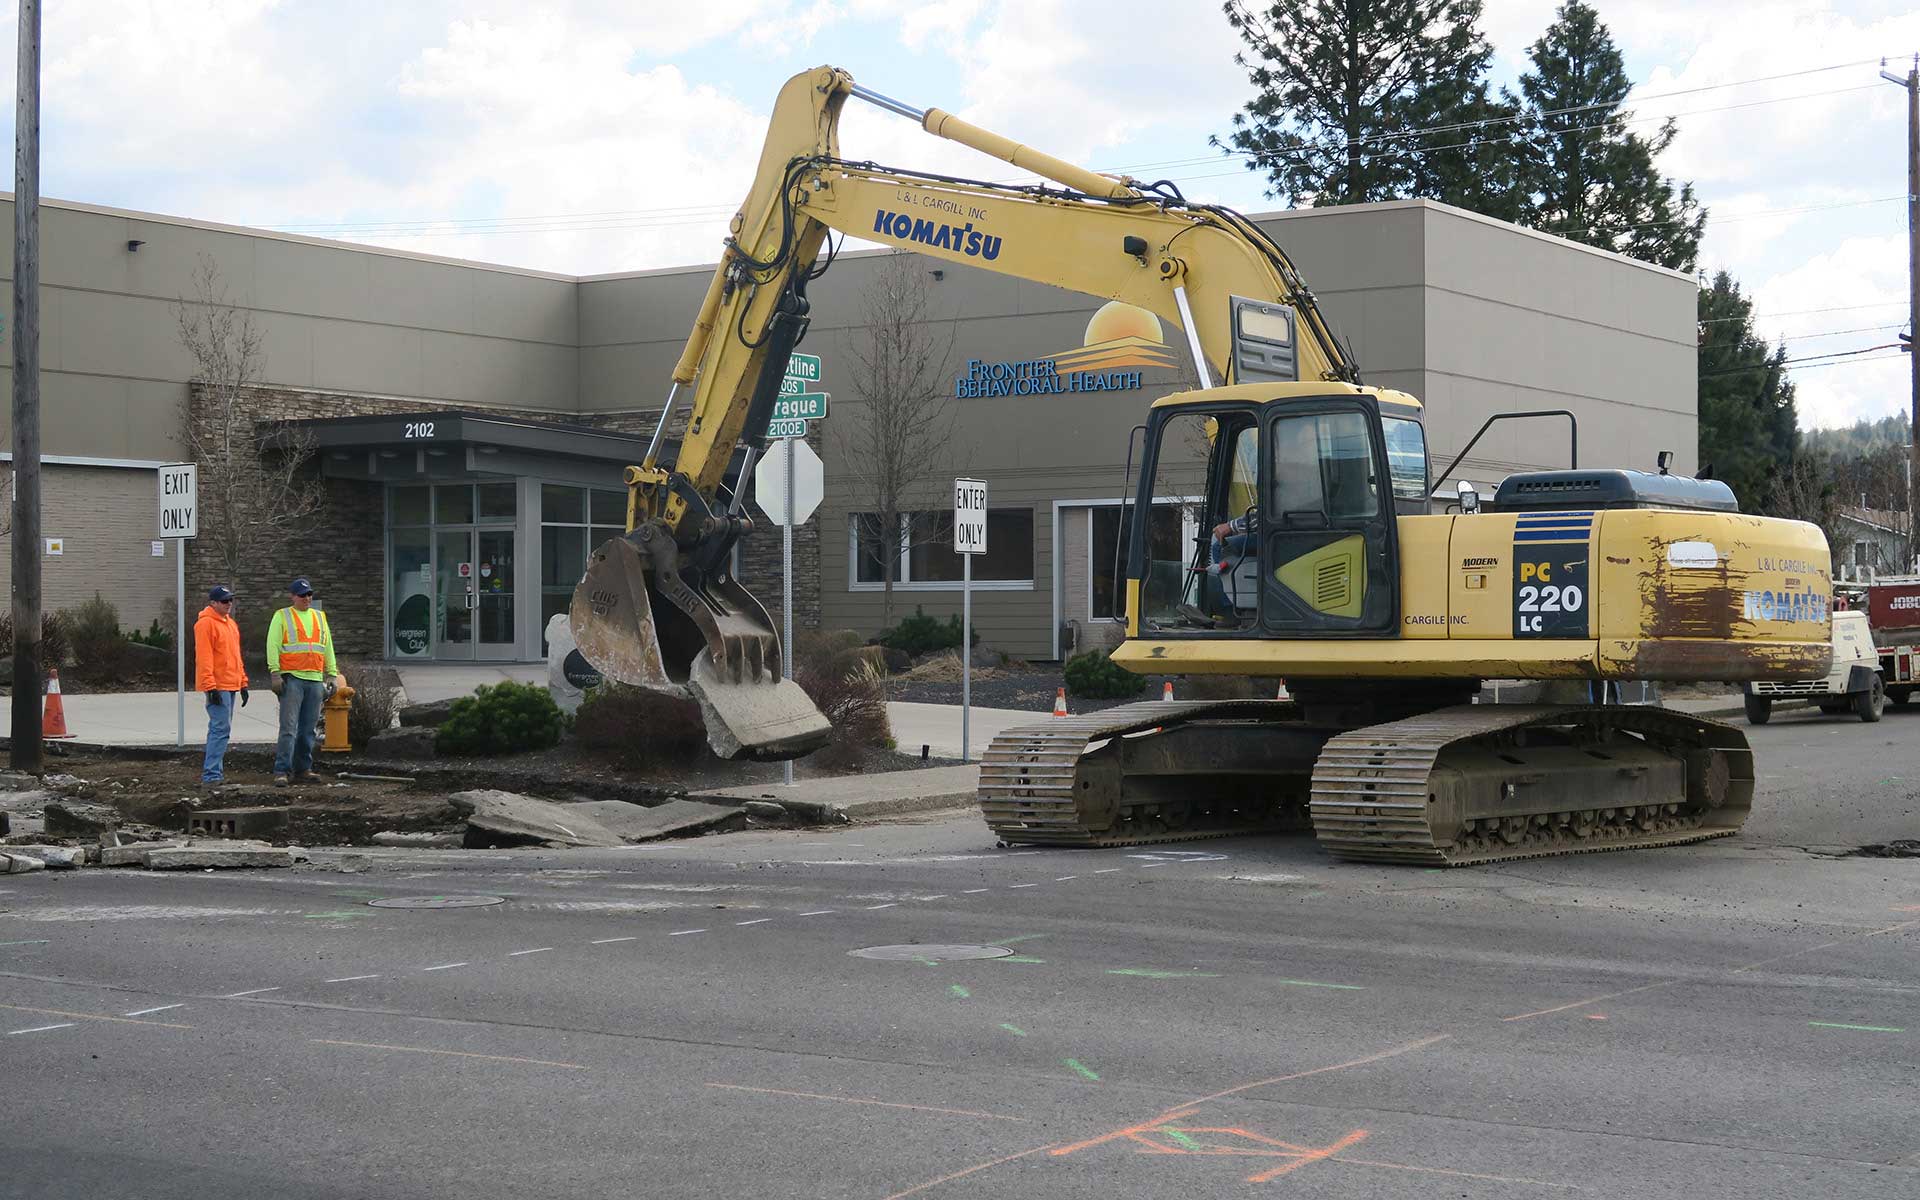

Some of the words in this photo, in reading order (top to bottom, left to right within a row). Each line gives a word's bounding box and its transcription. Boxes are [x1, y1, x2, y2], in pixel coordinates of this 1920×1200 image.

[903, 191, 911, 203] &
[922, 196, 964, 216] CARGILL
[967, 358, 1057, 381] FRONTIER
[956, 375, 1065, 398] BEHAVIORAL
[1069, 371, 1142, 393] HEALTH
[774, 399, 817, 417] rague
[405, 422, 434, 438] 2102
[769, 422, 802, 436] 2100E
[165, 473, 190, 495] EXIT
[957, 487, 985, 510] ENTER
[163, 503, 192, 530] ONLY
[959, 523, 983, 545] ONLY
[1462, 558, 1498, 567] MODERN
[1521, 562, 1551, 582] PC
[1518, 585, 1582, 612] 220
[1404, 615, 1445, 625] CARGILE
[1449, 615, 1470, 625] INC.
[1520, 616, 1542, 632] LC
